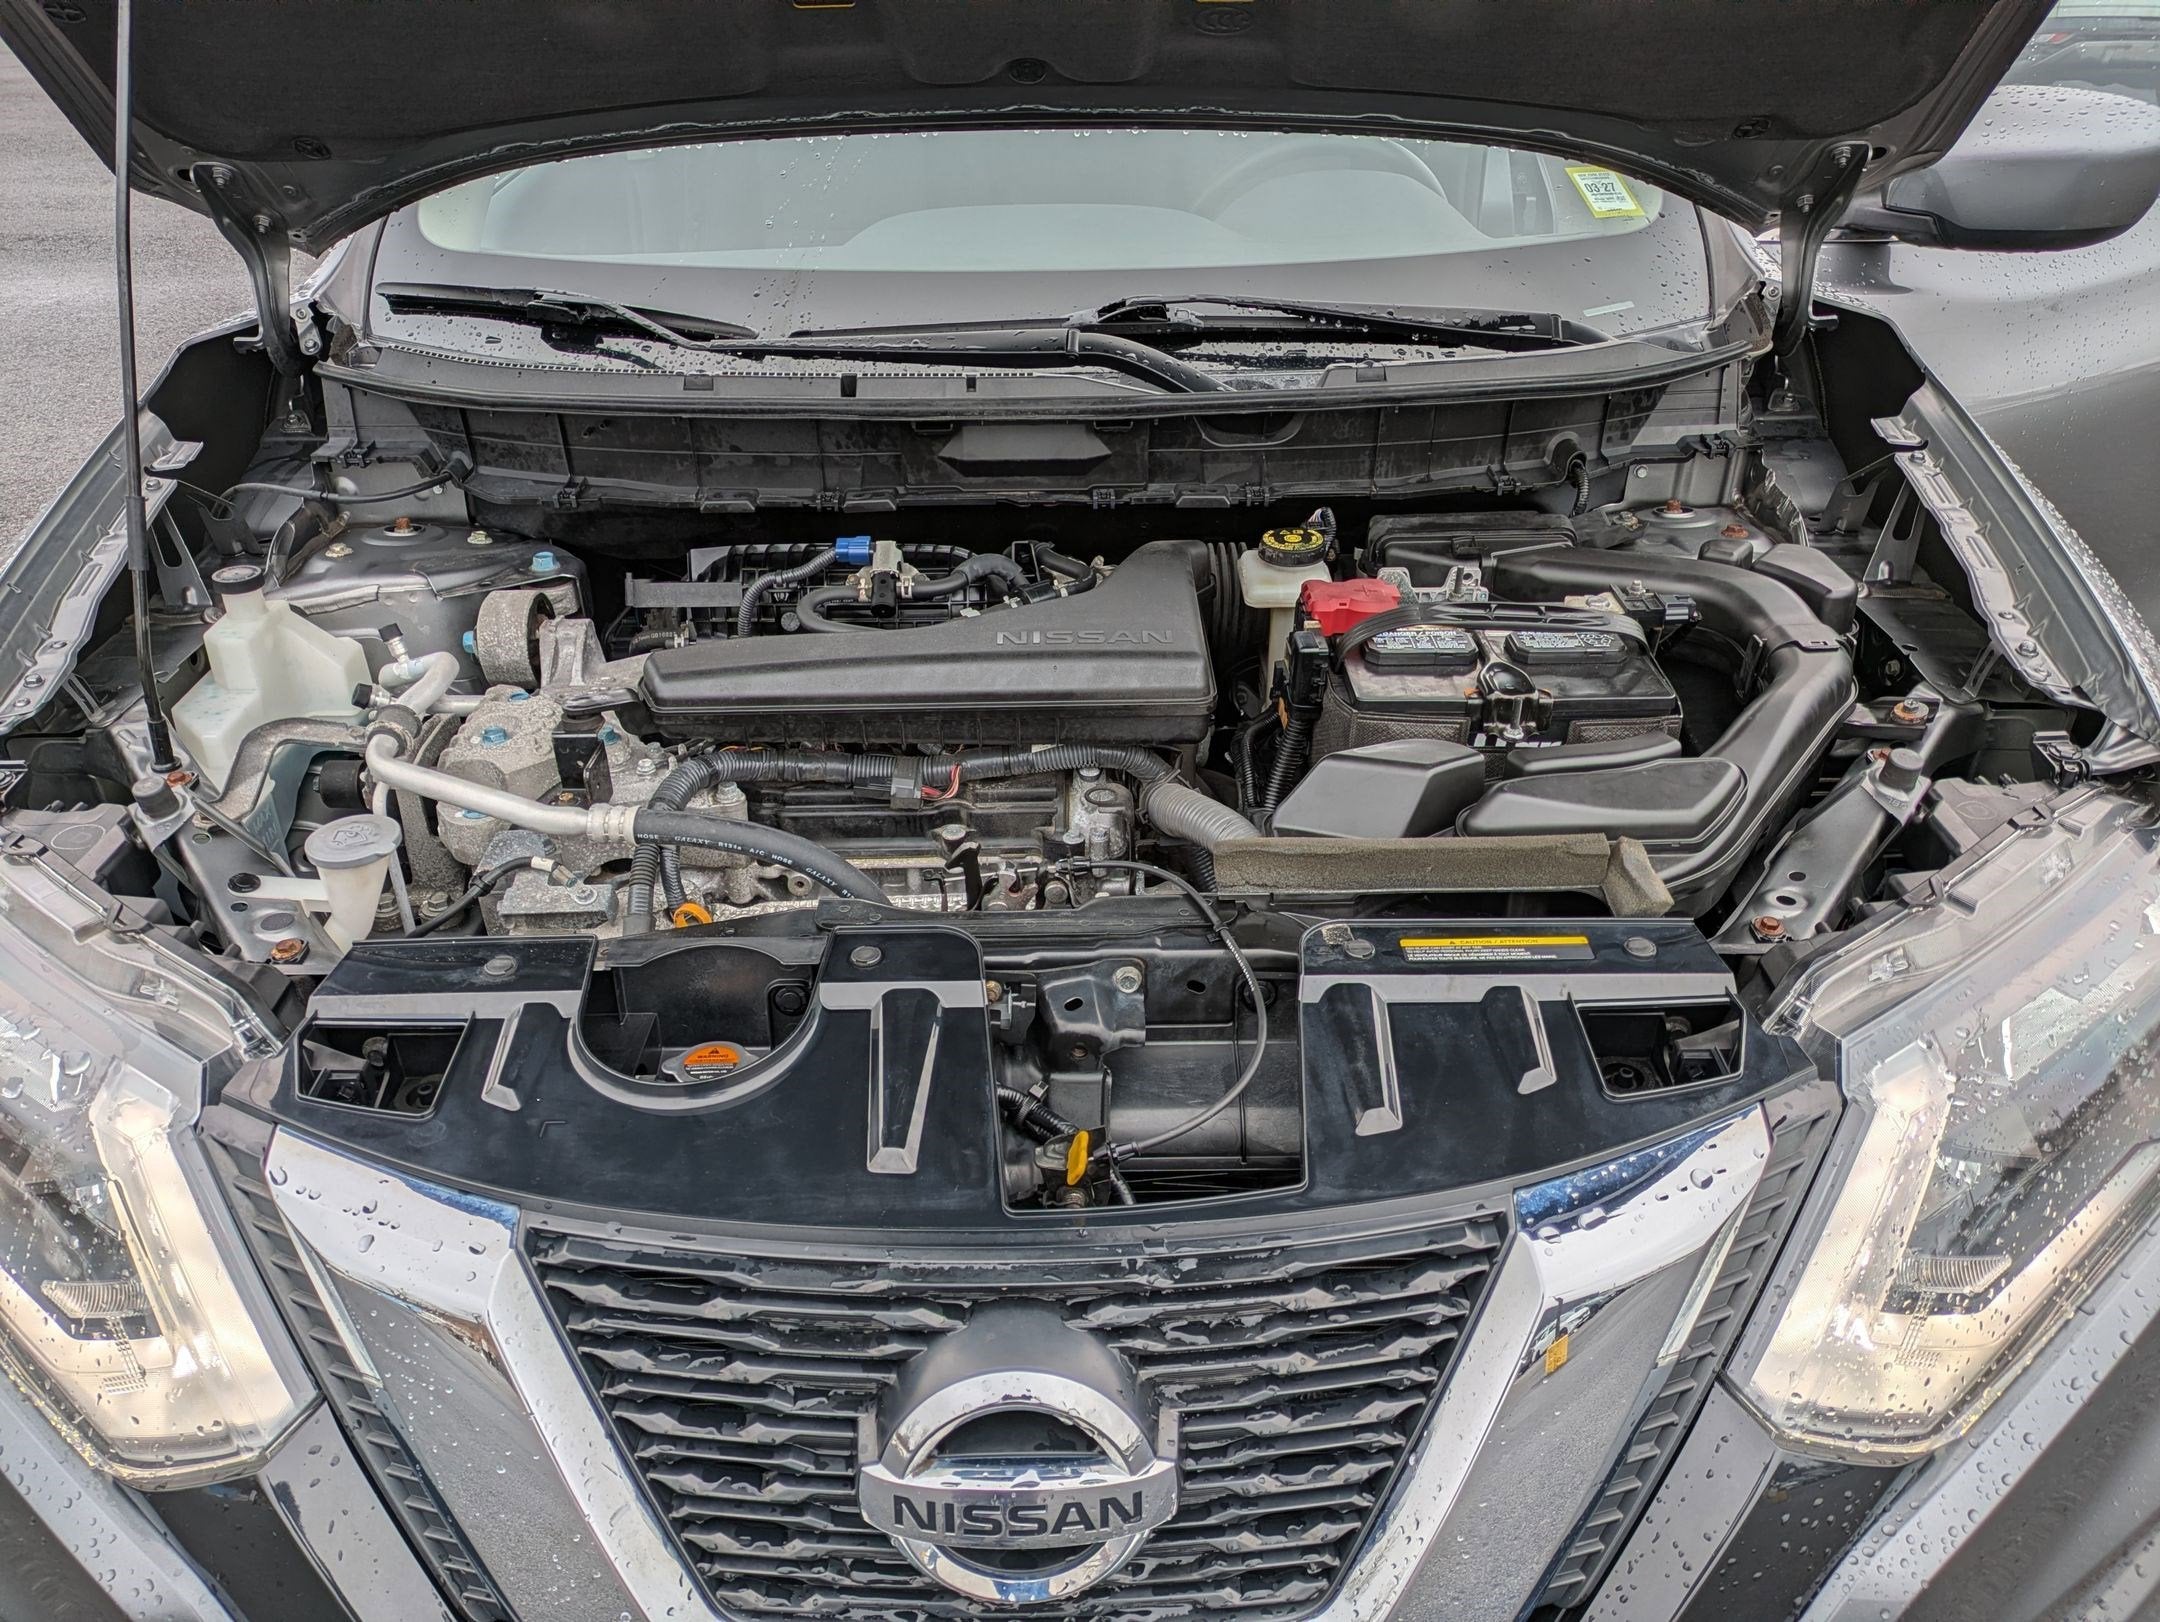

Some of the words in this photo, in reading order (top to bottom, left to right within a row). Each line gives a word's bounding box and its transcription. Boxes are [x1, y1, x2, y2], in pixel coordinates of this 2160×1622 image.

[996, 630, 1175, 645] NISSAN
[674, 835, 711, 845] GALAXY
[750, 847, 765, 857] A/C
[771, 853, 793, 866] HOSE
[805, 867, 838, 888] GALAXY
[893, 1490, 1143, 1537] NISSAN
